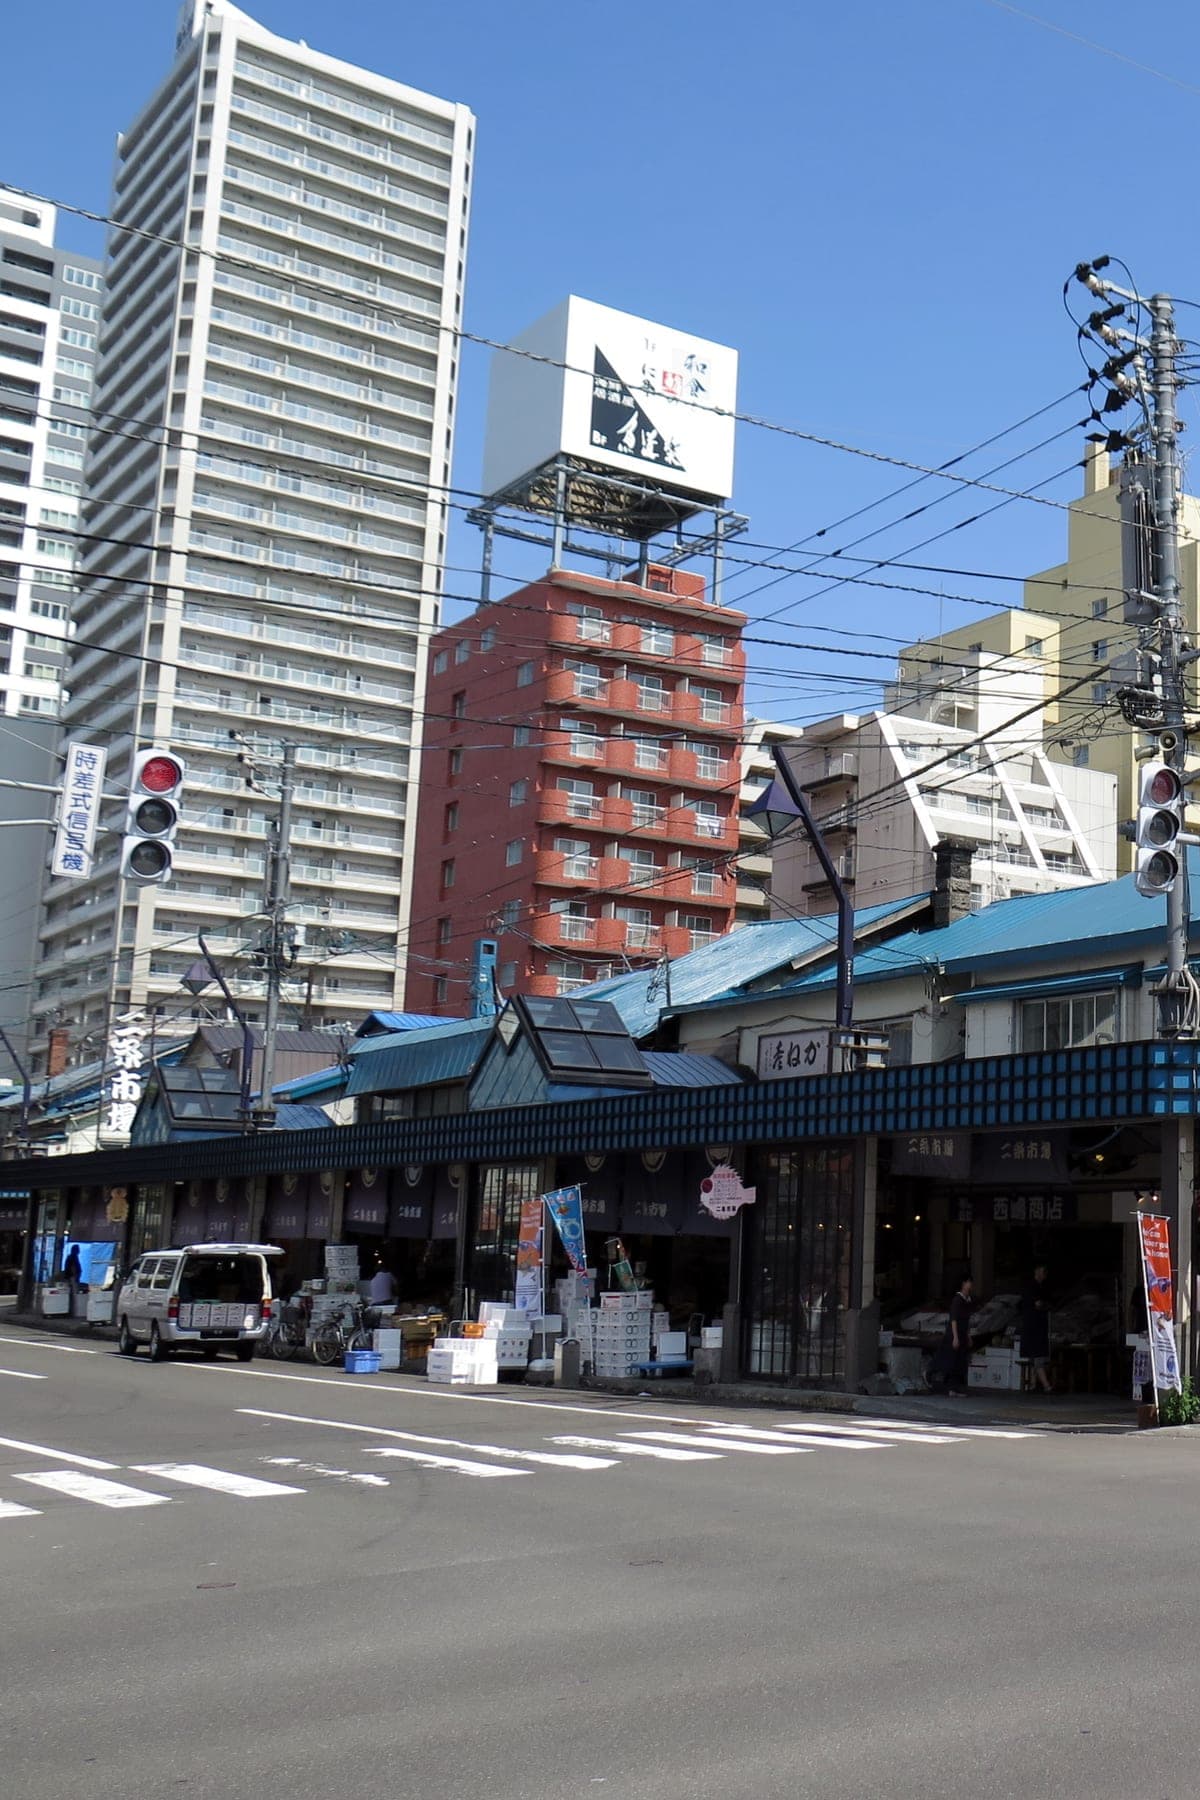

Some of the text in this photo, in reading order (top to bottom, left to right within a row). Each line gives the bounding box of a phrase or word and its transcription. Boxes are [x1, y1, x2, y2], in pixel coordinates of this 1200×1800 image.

[107, 1010, 146, 1134] 二条市場
[908, 1137, 954, 1157] 二条市場
[1000, 1140, 1051, 1160] 二条市場
